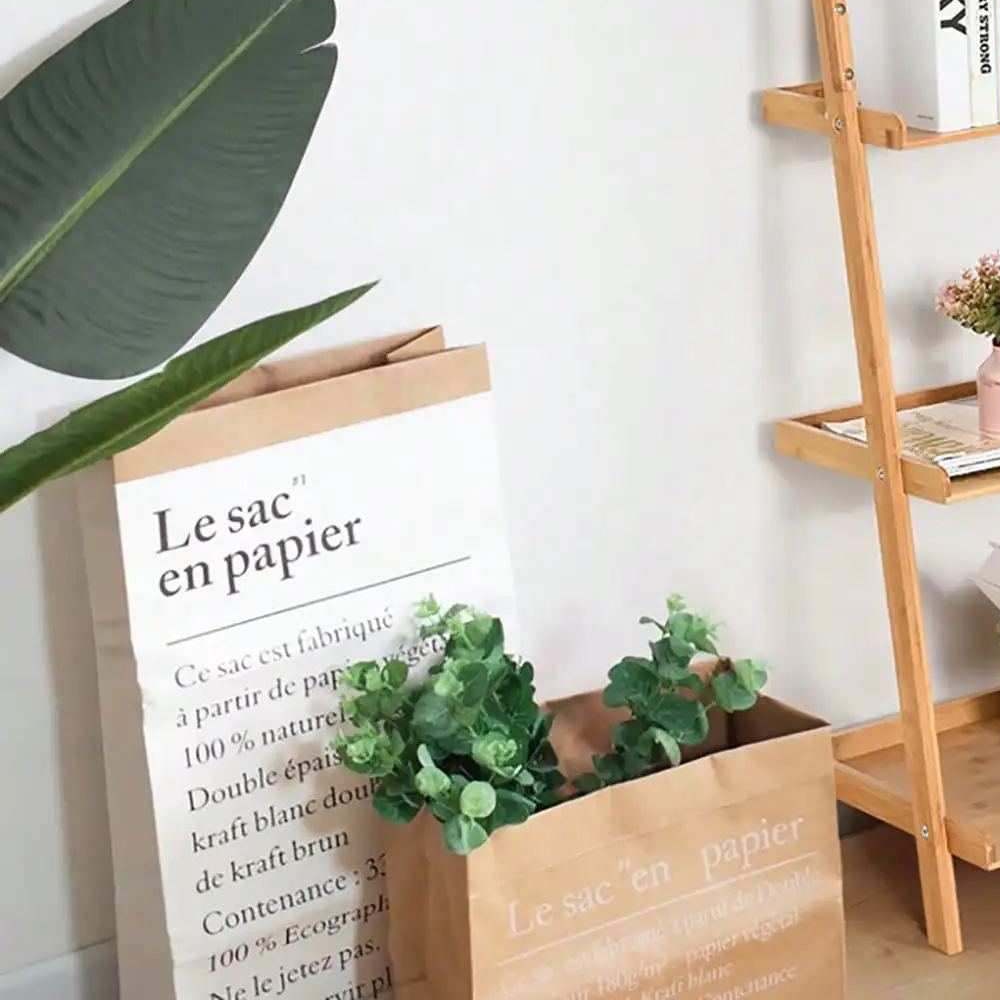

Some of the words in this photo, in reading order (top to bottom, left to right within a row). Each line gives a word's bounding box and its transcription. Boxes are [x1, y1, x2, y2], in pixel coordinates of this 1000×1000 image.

[978, 13, 992, 75] STRONG
[153, 507, 217, 554] Le
[227, 492, 293, 534] sac
[158, 560, 214, 597] en
[223, 517, 362, 595] papier
[174, 663, 211, 689] Ce
[216, 653, 253, 677] sac
[258, 642, 292, 666] est
[296, 606, 395, 655] fabriqué
[175, 708, 189, 729] à
[194, 681, 263, 729] partir
[267, 677, 297, 701] de
[183, 740, 226, 769] 100
[230, 728, 256, 754] %
[186, 767, 279, 812] Double
[191, 815, 248, 854] kraft
[253, 798, 317, 834] blanc
[195, 869, 224, 895] de
[229, 844, 289, 883] kraft
[291, 829, 350, 863] brun
[508, 900, 554, 938] Le
[562, 880, 615, 918] sac
[700, 816, 804, 881] papier
[201, 872, 347, 936] Contenance
[207, 943, 250, 973] 100
[254, 934, 277, 956] %
[252, 975, 274, 998] le
[275, 953, 334, 995] jetez
[338, 938, 382, 971] pas.
